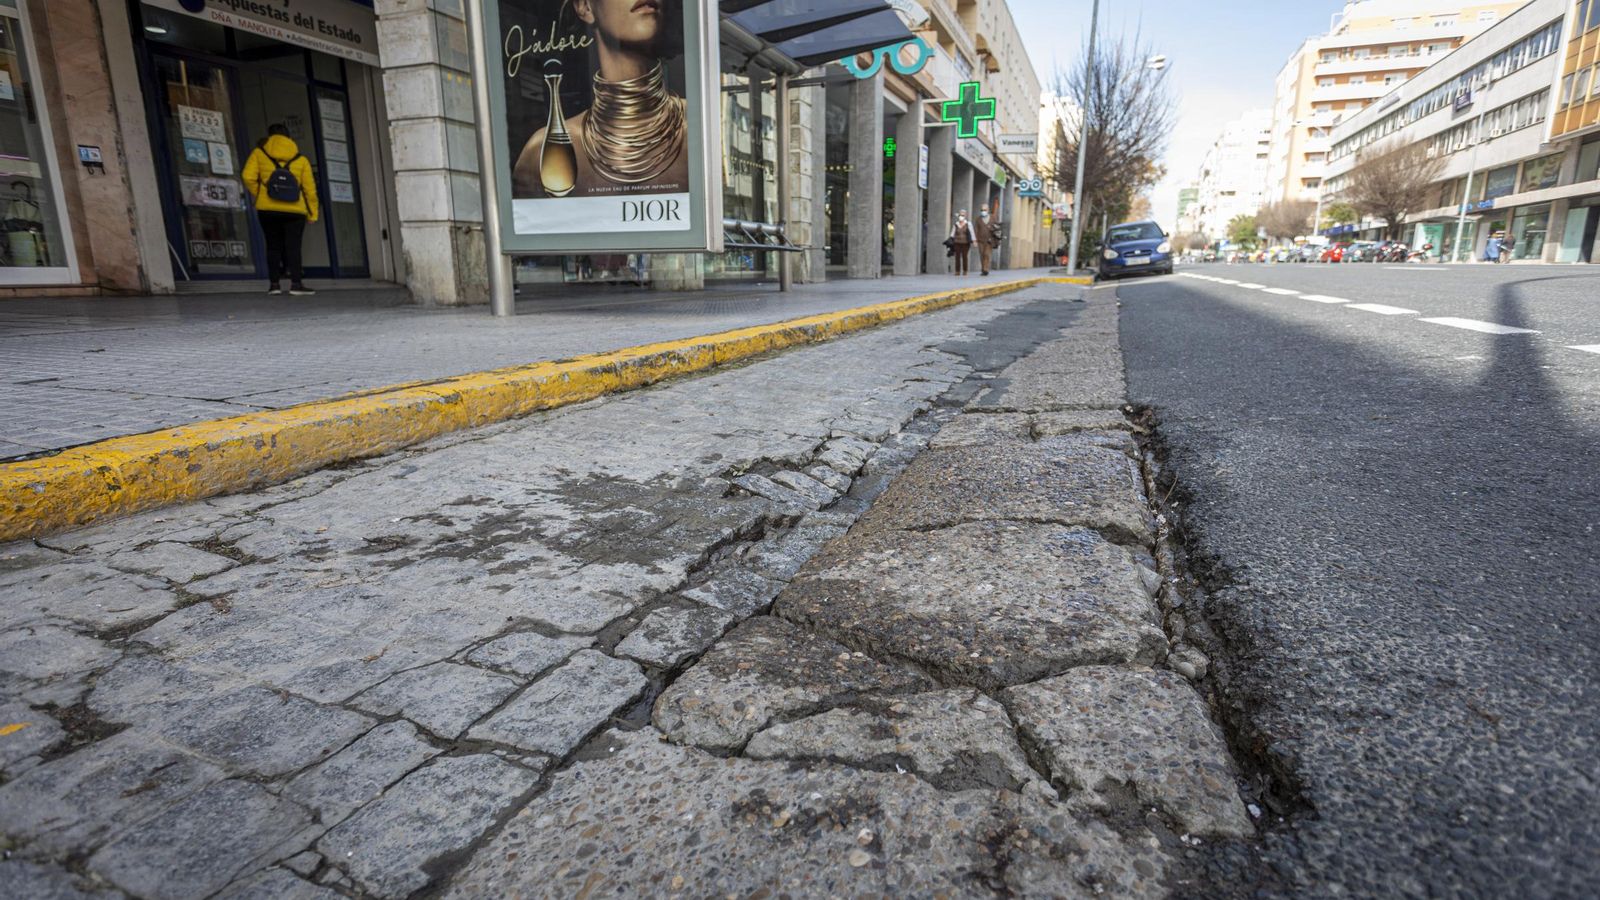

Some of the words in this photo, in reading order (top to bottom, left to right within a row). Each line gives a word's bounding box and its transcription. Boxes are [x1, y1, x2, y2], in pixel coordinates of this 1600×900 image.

[211, 10, 233, 24] DÑA
[239, 19, 283, 38] MANOLITA
[291, 33, 344, 55] Administración
[294, 12, 314, 31] del
[319, 19, 362, 44] Estado
[505, 21, 594, 77] J'adore
[622, 199, 681, 222] DIOR
